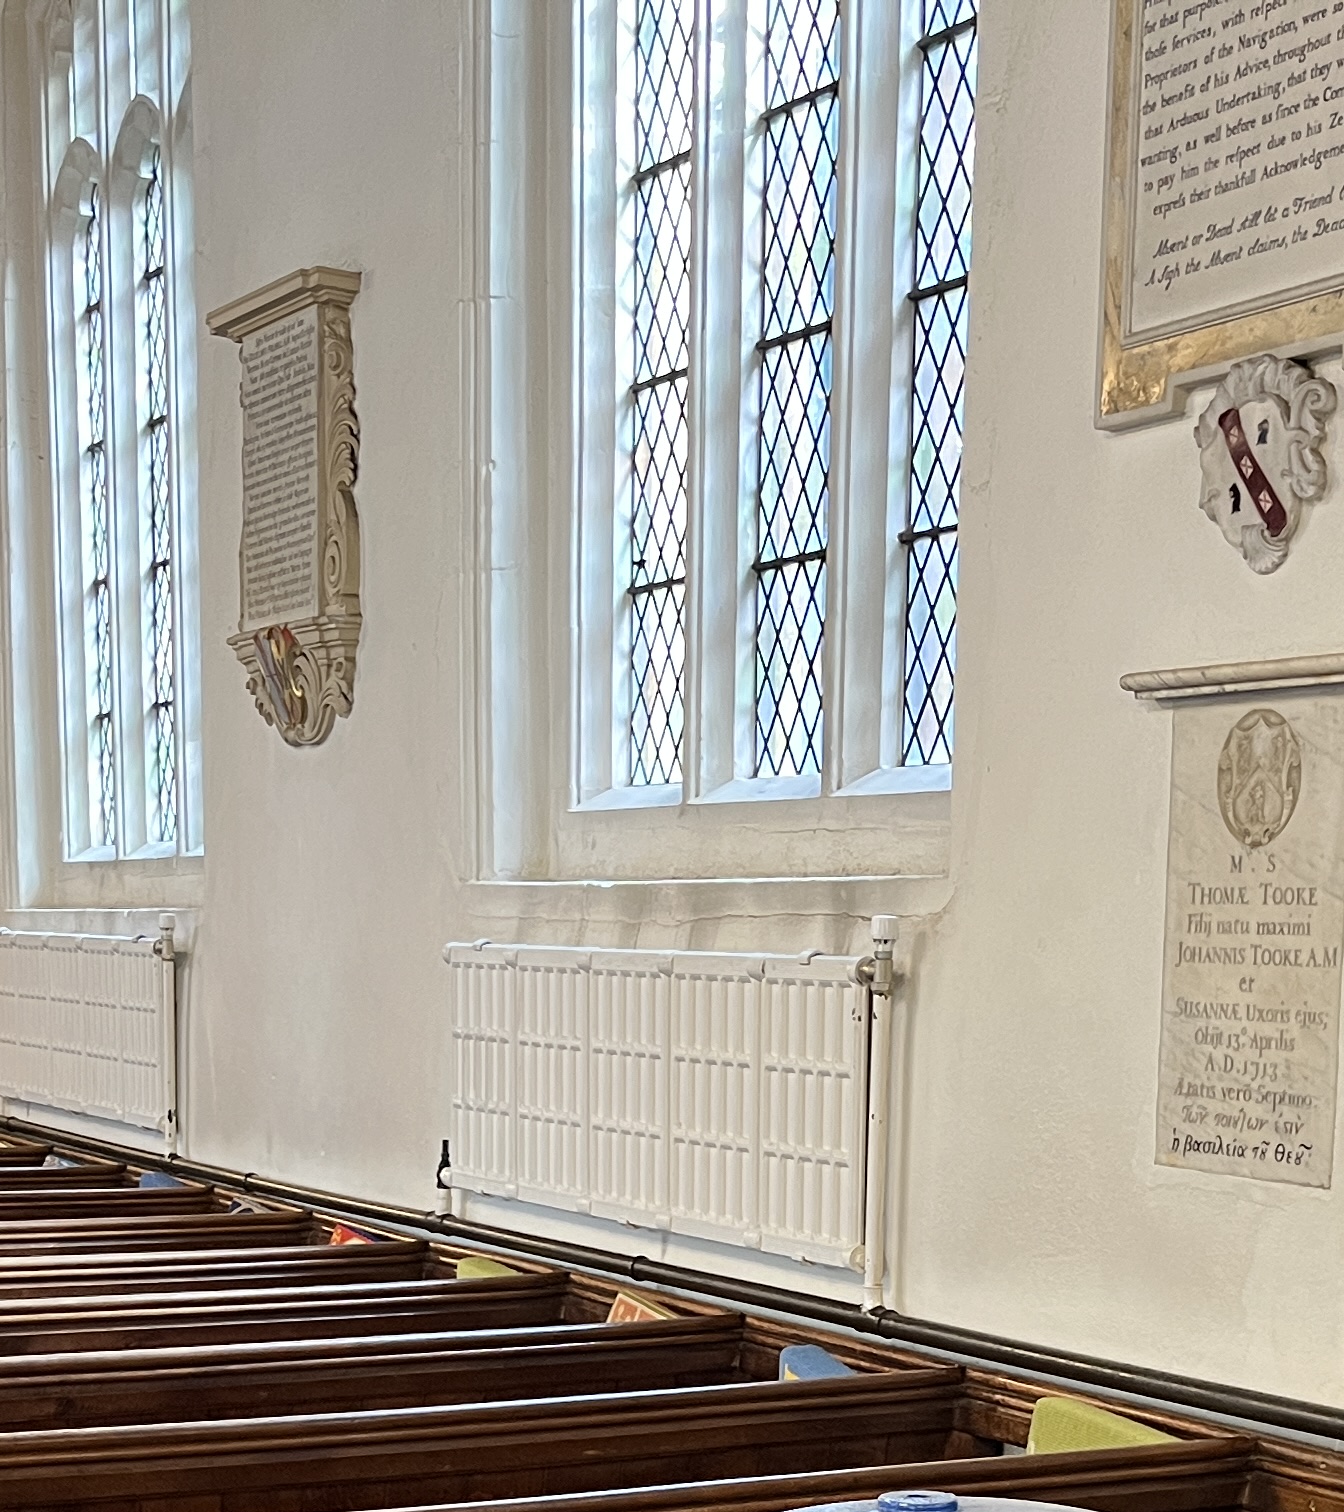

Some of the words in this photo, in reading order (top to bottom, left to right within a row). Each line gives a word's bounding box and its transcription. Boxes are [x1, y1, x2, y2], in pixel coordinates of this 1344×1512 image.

[1159, 11, 1179, 29] that
[1221, 8, 1245, 30] with
[1145, 58, 1197, 91] Proprietors
[1203, 46, 1215, 65] of
[1218, 43, 1233, 59] the
[1237, 20, 1298, 53] Navigation,
[1302, 8, 1328, 26] were
[1332, 1, 1344, 15] so
[1142, 98, 1157, 116] the
[1160, 83, 1195, 108] benefit
[1199, 75, 1211, 93] of
[1214, 71, 1230, 89] his
[1233, 58, 1271, 82] Advice,
[1273, 32, 1332, 65] throughout
[1144, 124, 1164, 141] that
[1166, 107, 1210, 134] Arduous
[1215, 80, 1286, 114] Undertaking,
[1287, 68, 1307, 88] that
[1310, 61, 1333, 82] they
[1140, 144, 1182, 168] wanting,
[1185, 138, 1198, 152] as
[1203, 124, 1222, 145] well
[1225, 117, 1257, 138] before
[1261, 112, 1273, 126] as
[1303, 93, 1320, 110] the
[1143, 181, 1154, 192] to
[1157, 173, 1176, 196] pay
[1180, 163, 1199, 181] him
[1203, 156, 1220, 173] the
[1266, 134, 1287, 150] due
[1290, 130, 1302, 142] to
[1306, 119, 1323, 138] his
[1189, 187, 1212, 204] their
[1214, 167, 1257, 197] thankfull
[1191, 233, 1204, 247] or
[1281, 206, 1290, 219] a
[1291, 185, 1336, 216] Friend
[1185, 257, 1201, 275] the
[1291, 224, 1309, 244] the
[1259, 882, 1319, 907] TOOKE
[1256, 913, 1312, 937] maximi
[1175, 941, 1246, 968] JOHANNIS
[1250, 944, 1303, 967] TOOKE
[1246, 1000, 1291, 1024] Uxoris
[1249, 1029, 1296, 1059] Aprilis
